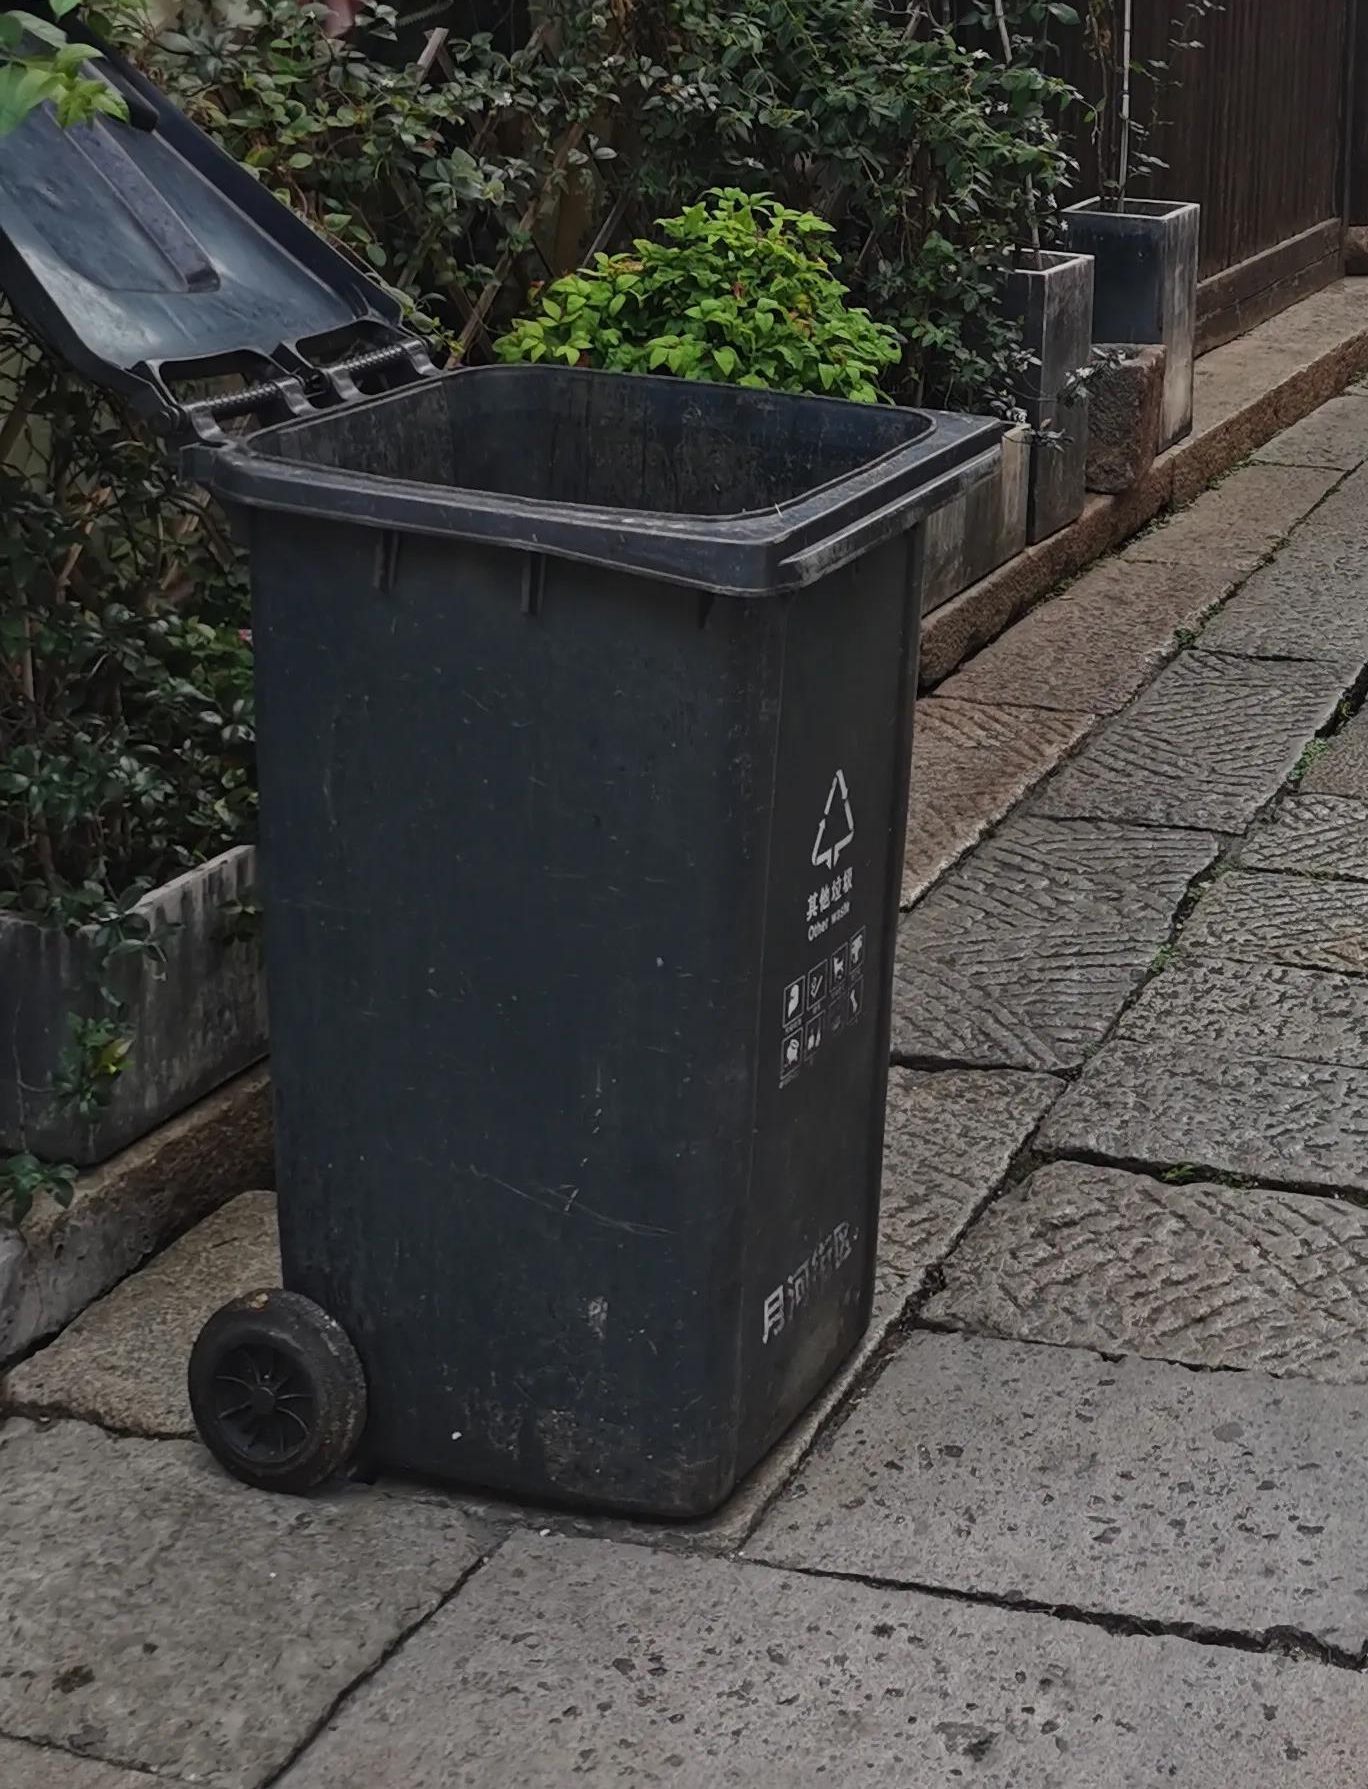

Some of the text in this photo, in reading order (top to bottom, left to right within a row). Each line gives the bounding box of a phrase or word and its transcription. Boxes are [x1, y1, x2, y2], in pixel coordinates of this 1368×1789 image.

[806, 866, 853, 922] 其他垃圾
[808, 917, 829, 941] Other
